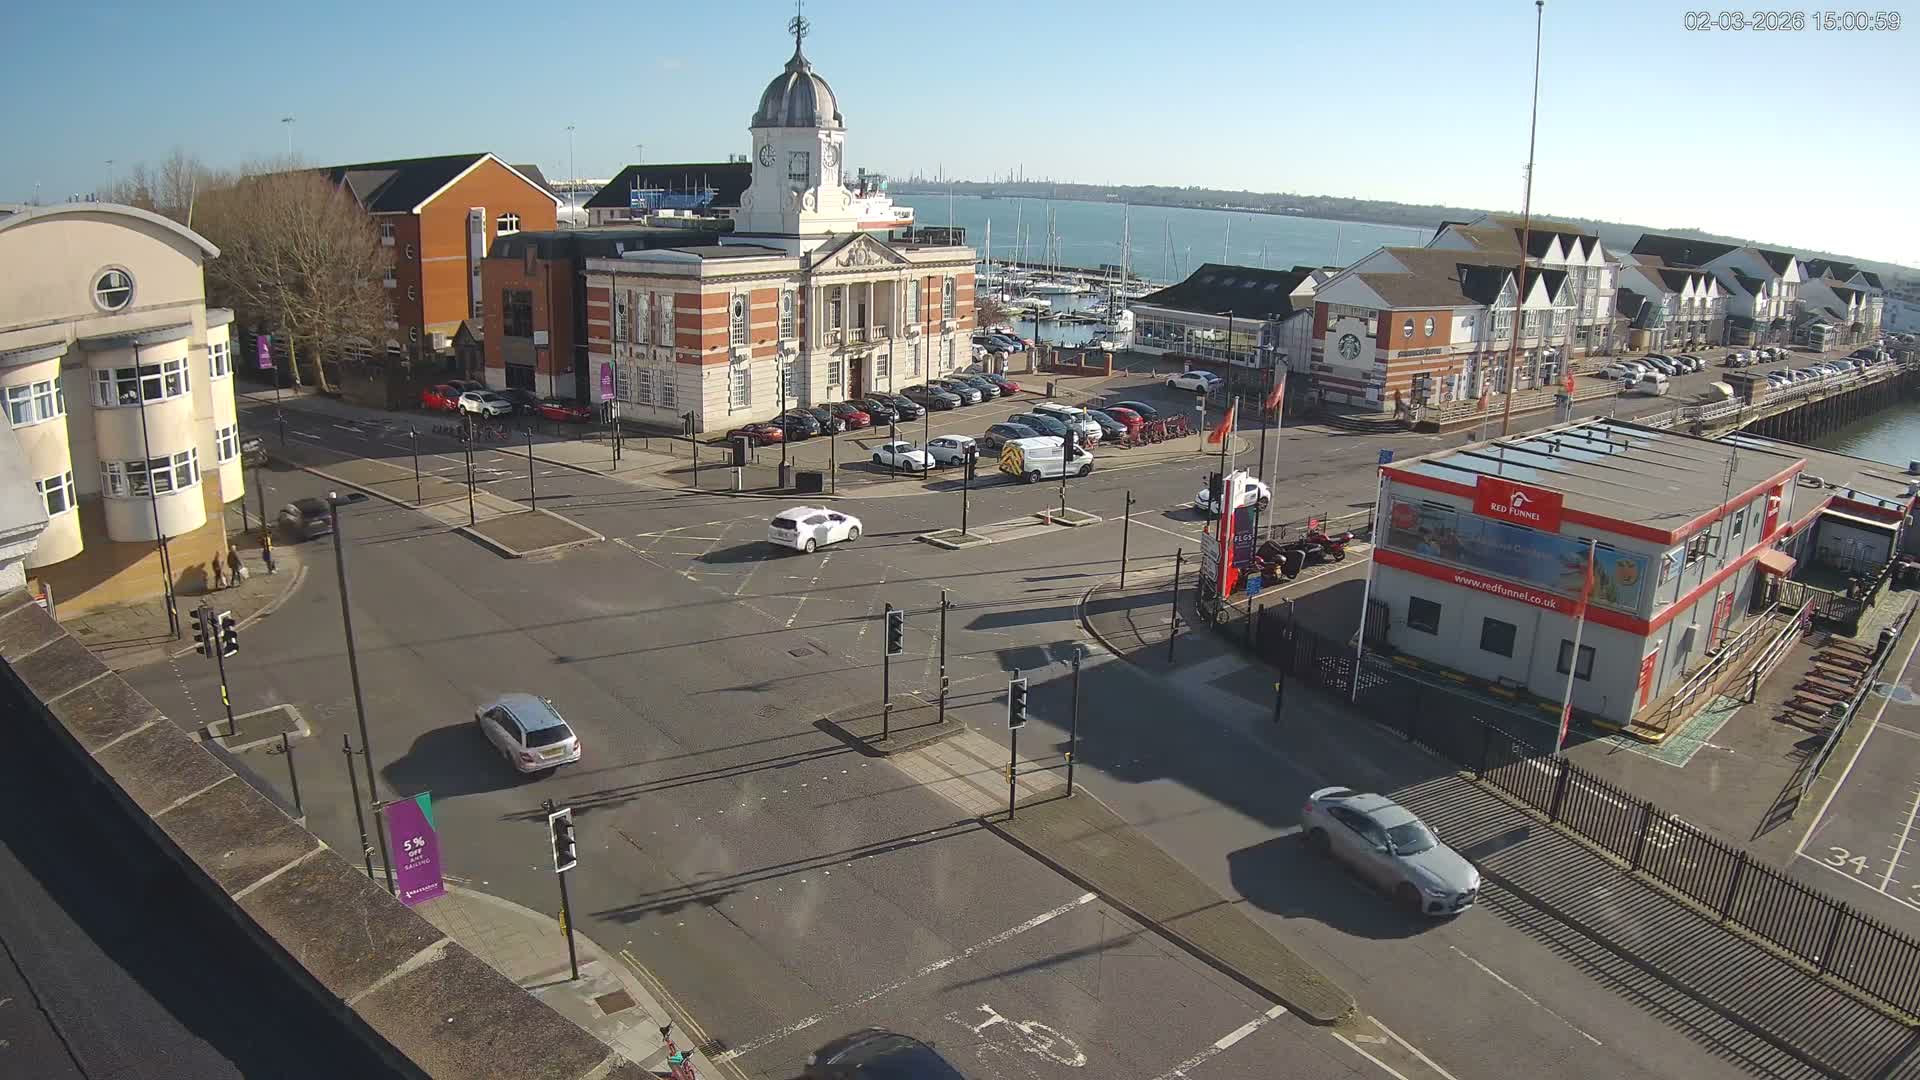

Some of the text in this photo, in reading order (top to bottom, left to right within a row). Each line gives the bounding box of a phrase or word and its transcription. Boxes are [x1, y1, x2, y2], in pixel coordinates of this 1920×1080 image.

[1490, 502, 1540, 521] RED FUNNEL
[1454, 575, 1556, 608] www.redfunnel.co.uk
[403, 836, 425, 852] 5%
[409, 848, 423, 858] OFF
[1824, 846, 1871, 875] 34
